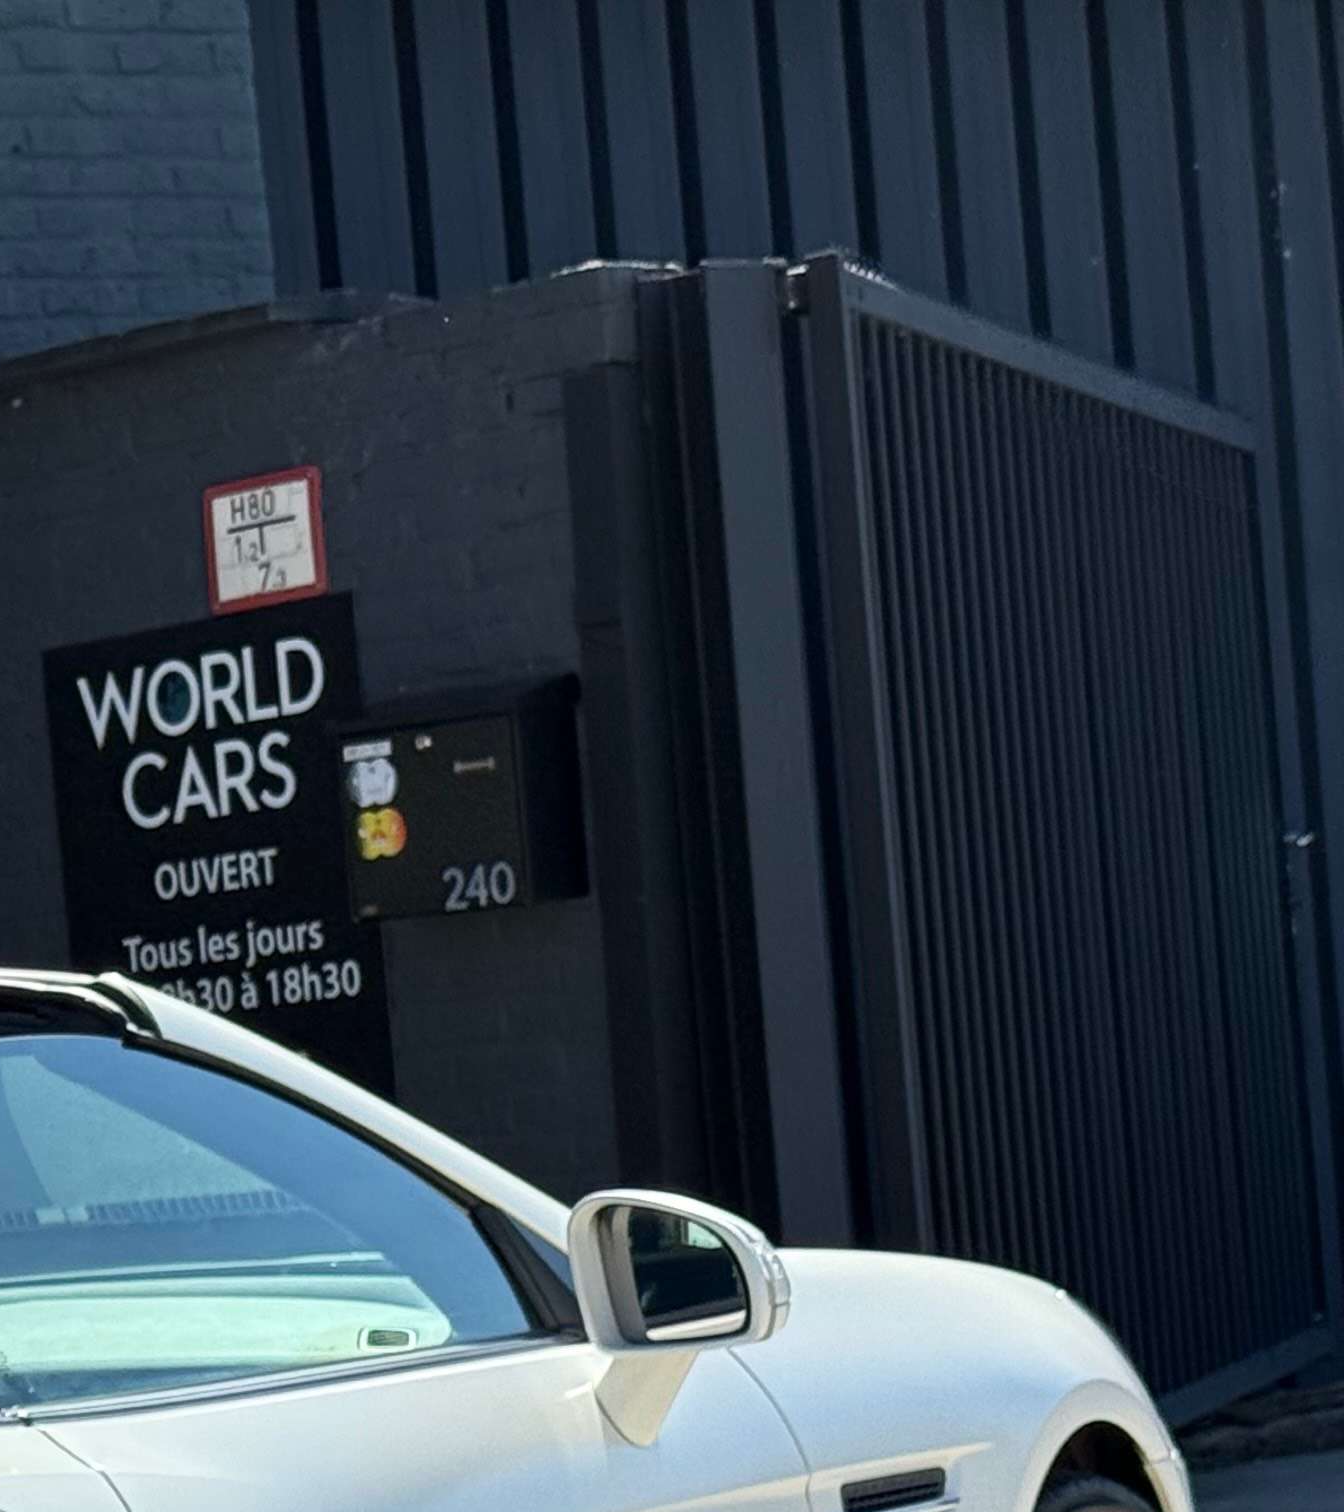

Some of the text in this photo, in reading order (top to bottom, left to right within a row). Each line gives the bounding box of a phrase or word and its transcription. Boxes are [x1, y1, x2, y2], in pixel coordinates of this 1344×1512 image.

[230, 487, 275, 523] H80
[76, 637, 324, 751] WORLD
[122, 731, 297, 829] CARS
[154, 848, 278, 900] OUVERT
[442, 861, 515, 912] 240
[122, 920, 325, 973] Tous les jours
[241, 970, 260, 1010] à
[265, 959, 362, 1006] 18h30
